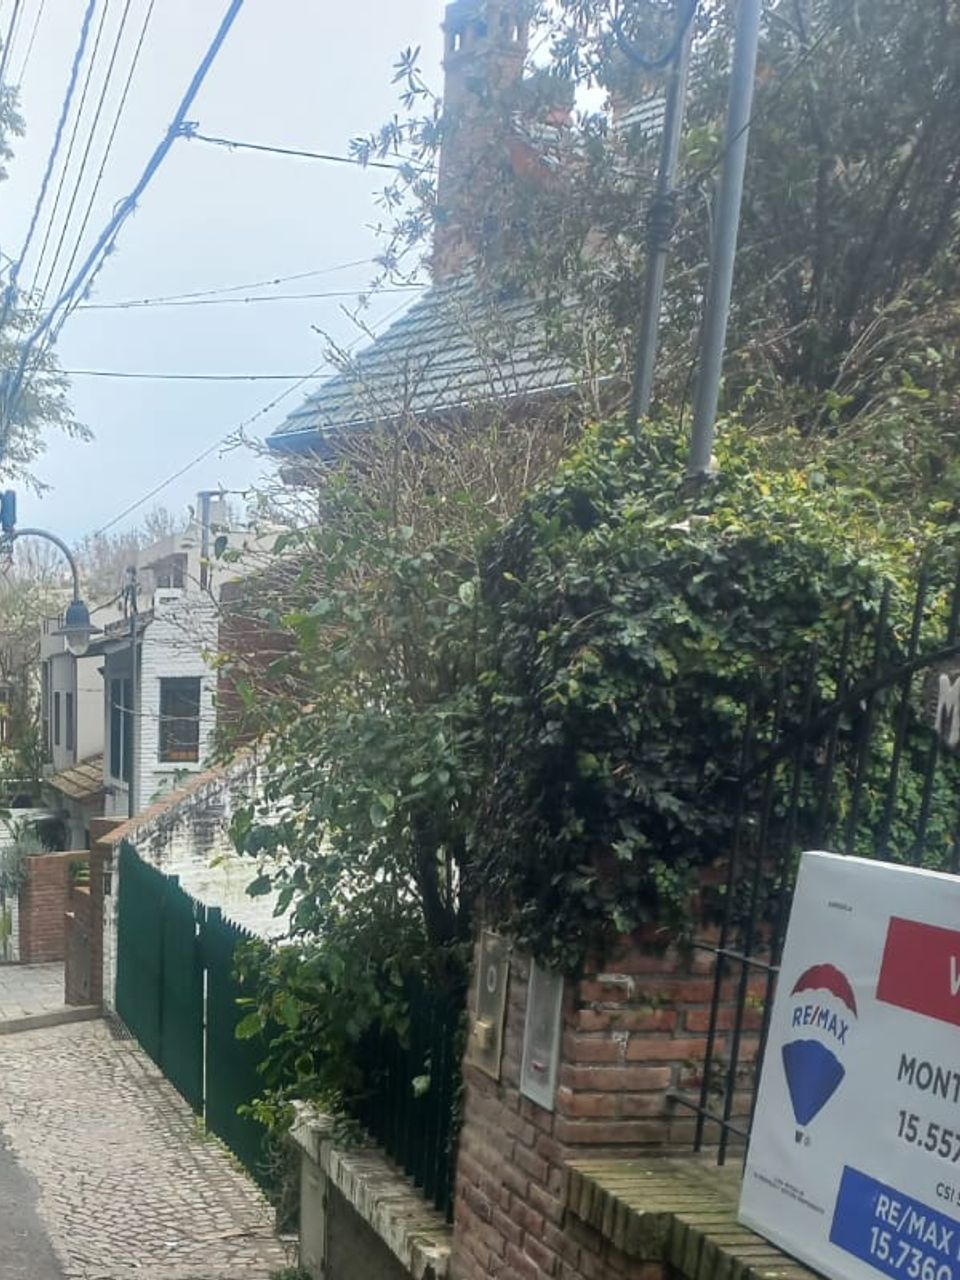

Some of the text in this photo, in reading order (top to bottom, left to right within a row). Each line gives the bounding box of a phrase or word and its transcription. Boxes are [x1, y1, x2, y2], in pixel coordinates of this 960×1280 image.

[792, 1005, 849, 1046] RE/MAX
[936, 1182, 955, 1202] CSI
[875, 1194, 954, 1255] RE/MAX
